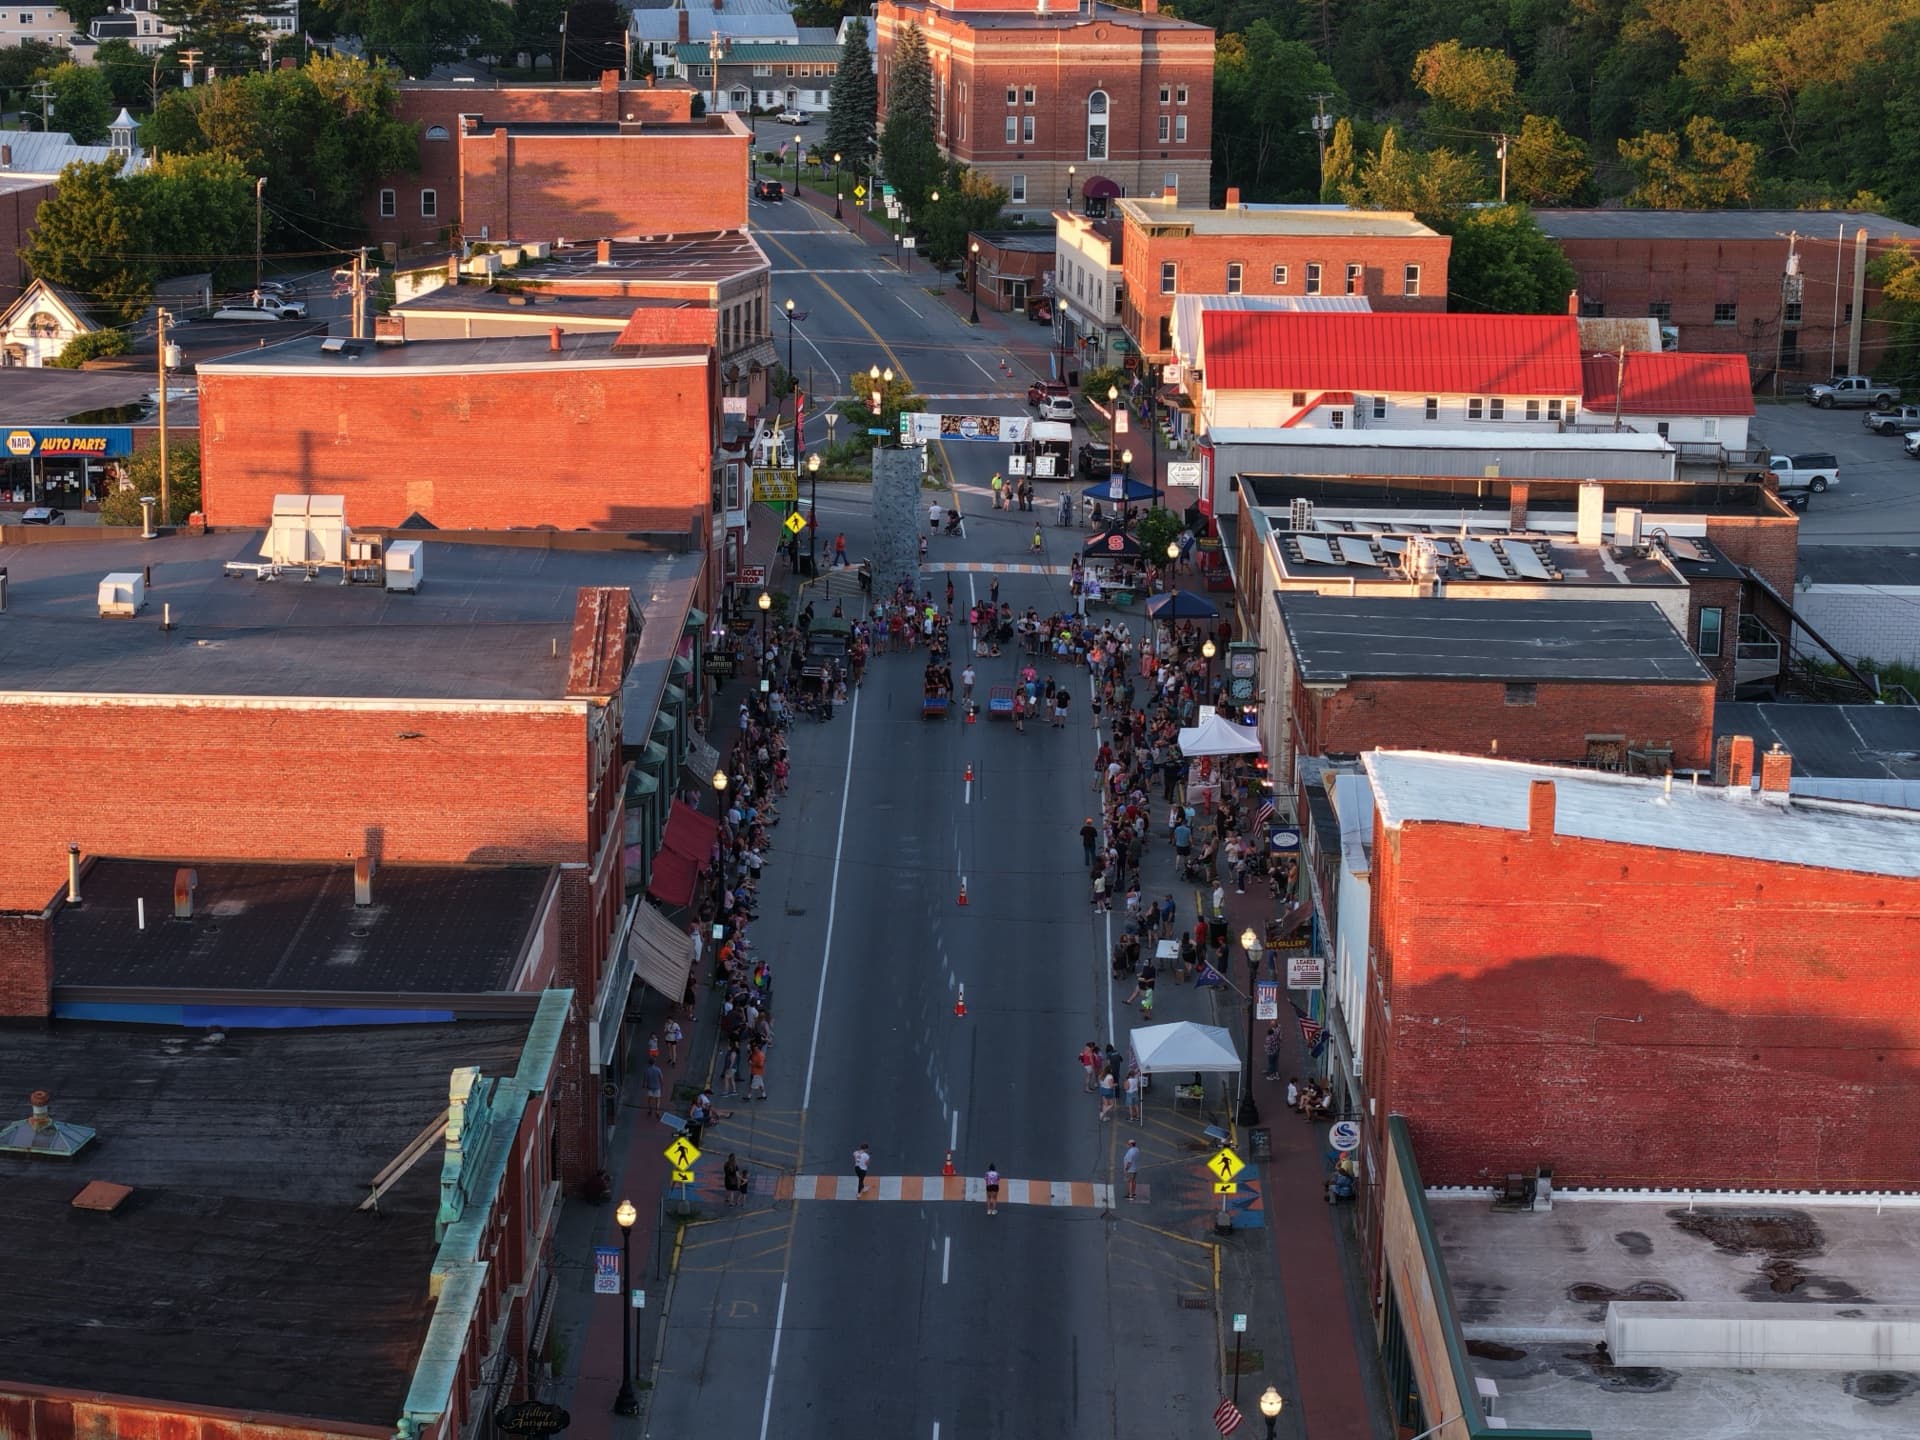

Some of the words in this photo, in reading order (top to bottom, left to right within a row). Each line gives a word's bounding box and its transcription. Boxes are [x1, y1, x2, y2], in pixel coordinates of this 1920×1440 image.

[11, 438, 31, 449] NAPA
[40, 438, 71, 450] AUTO
[72, 438, 107, 451] PARTS
